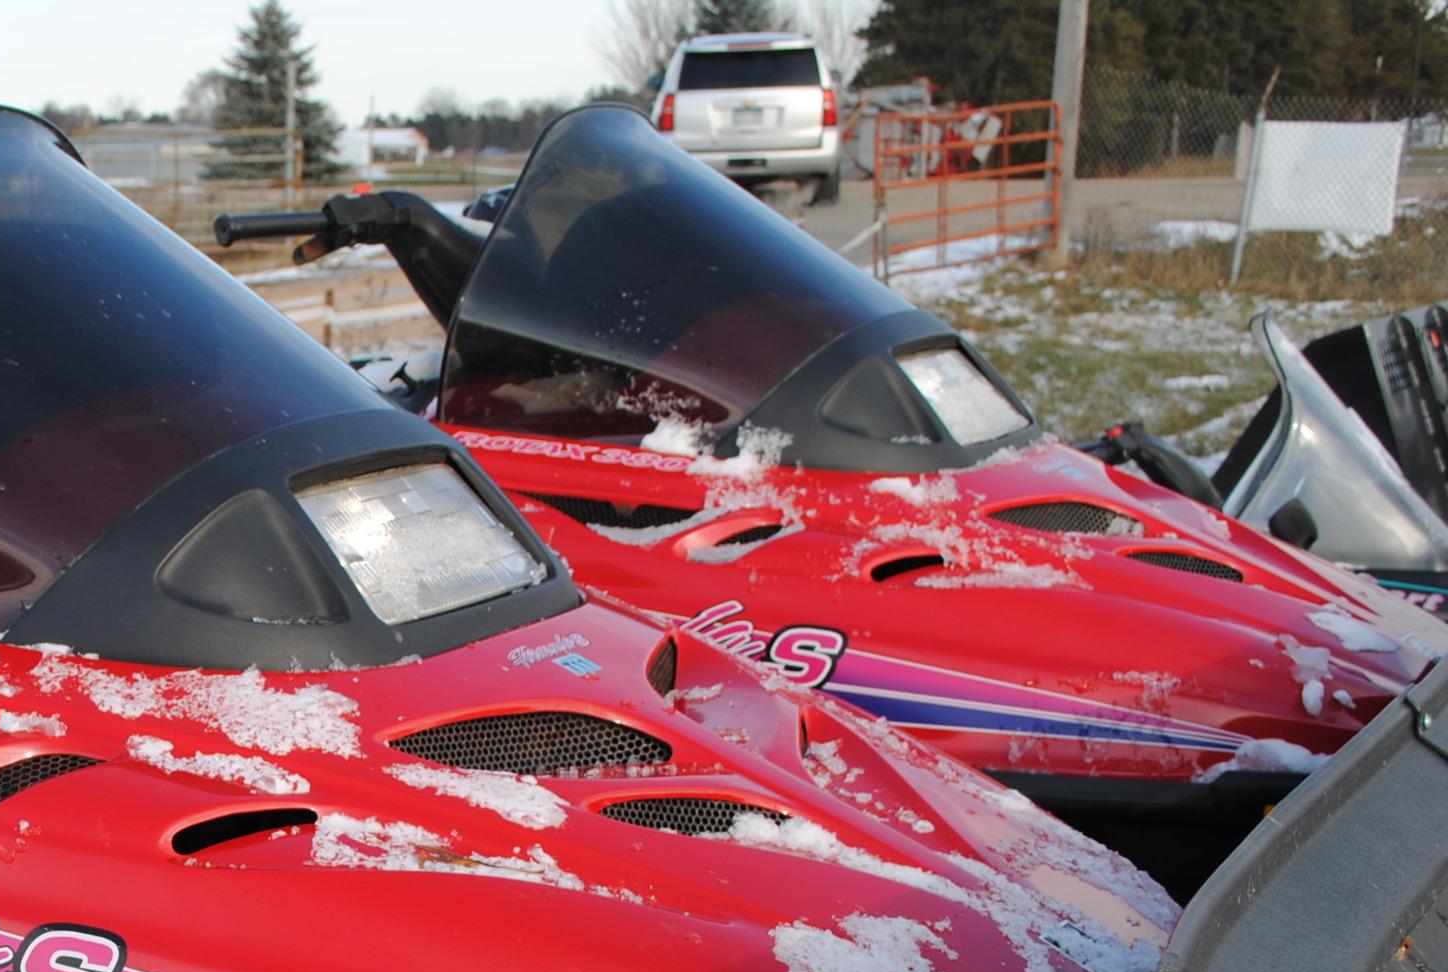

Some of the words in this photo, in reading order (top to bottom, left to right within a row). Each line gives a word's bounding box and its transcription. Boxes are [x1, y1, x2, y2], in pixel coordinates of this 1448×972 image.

[453, 430, 600, 460] ROTAX
[592, 448, 692, 472] 380
[769, 625, 847, 689] S
